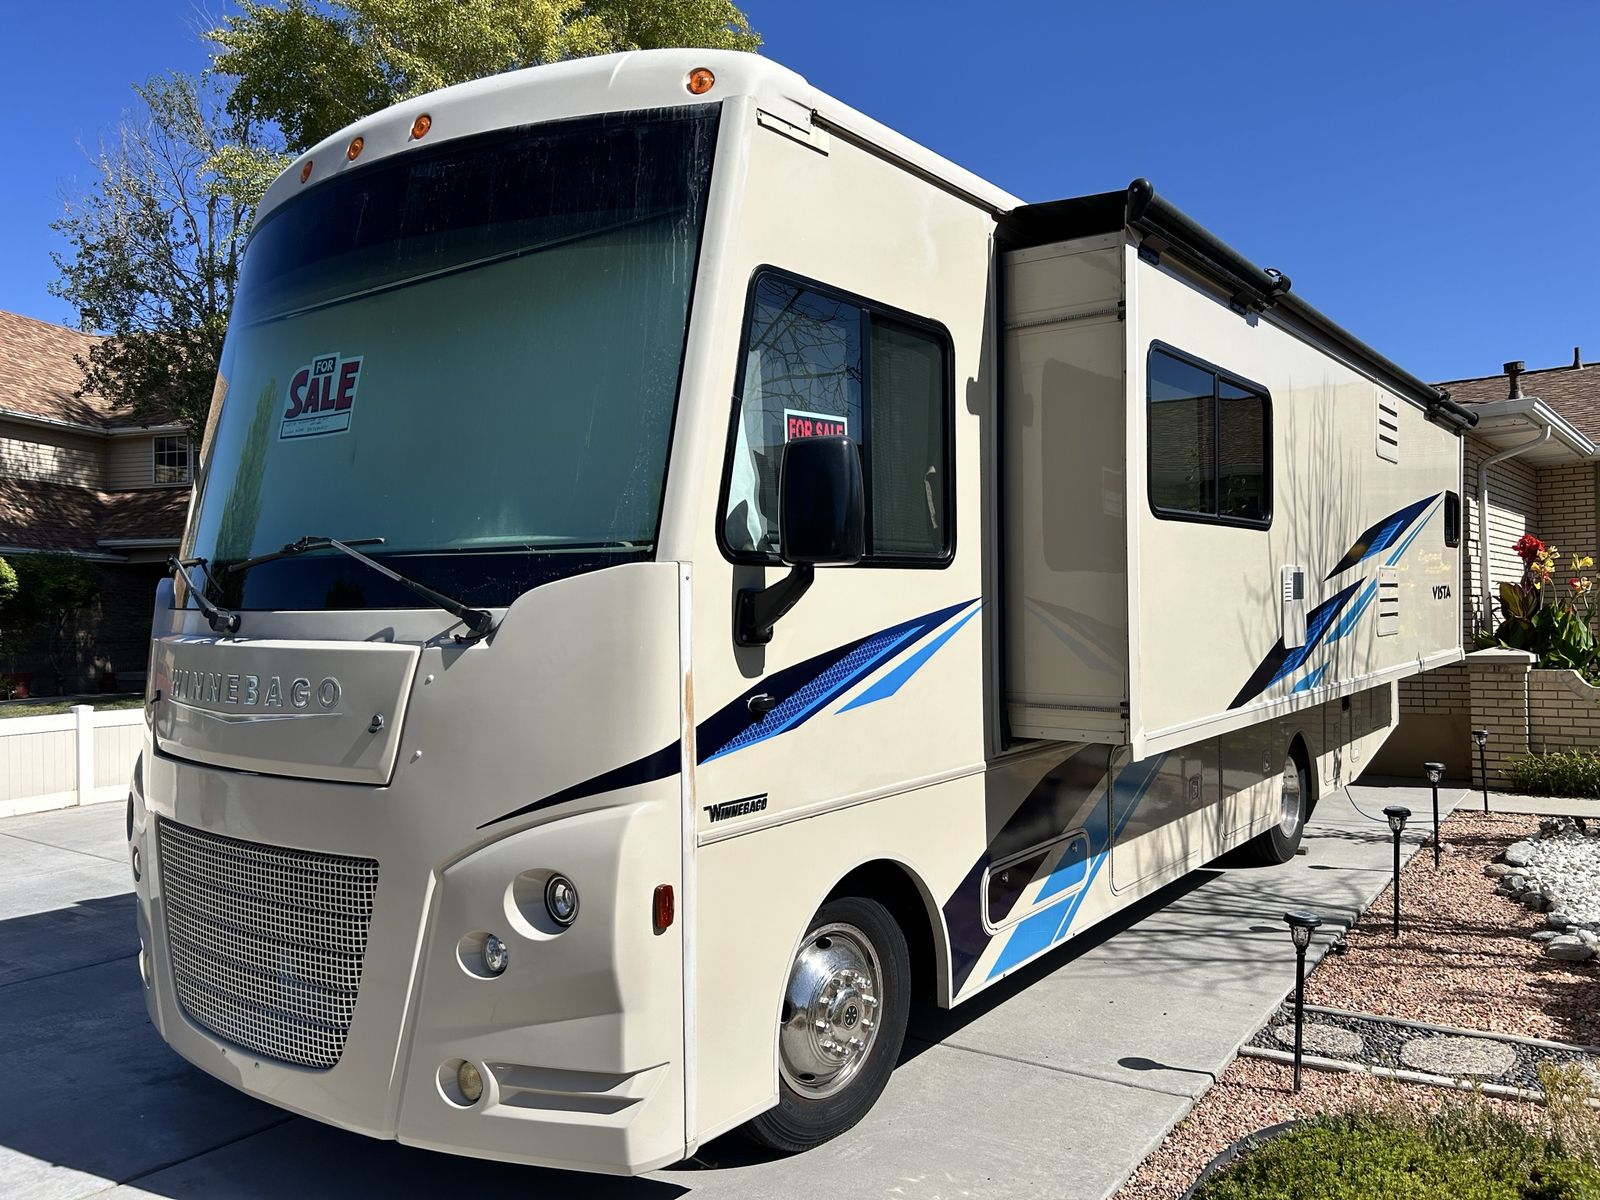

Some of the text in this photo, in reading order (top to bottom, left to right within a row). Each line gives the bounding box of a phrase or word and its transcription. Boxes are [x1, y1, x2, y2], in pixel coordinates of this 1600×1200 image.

[315, 359, 334, 374] FOR
[284, 361, 360, 419] SALE
[788, 417, 813, 440] FOR
[1432, 585, 1451, 600] VISTA
[170, 668, 343, 710] WINNEBAGO
[703, 793, 768, 823] WINNEBAGO
